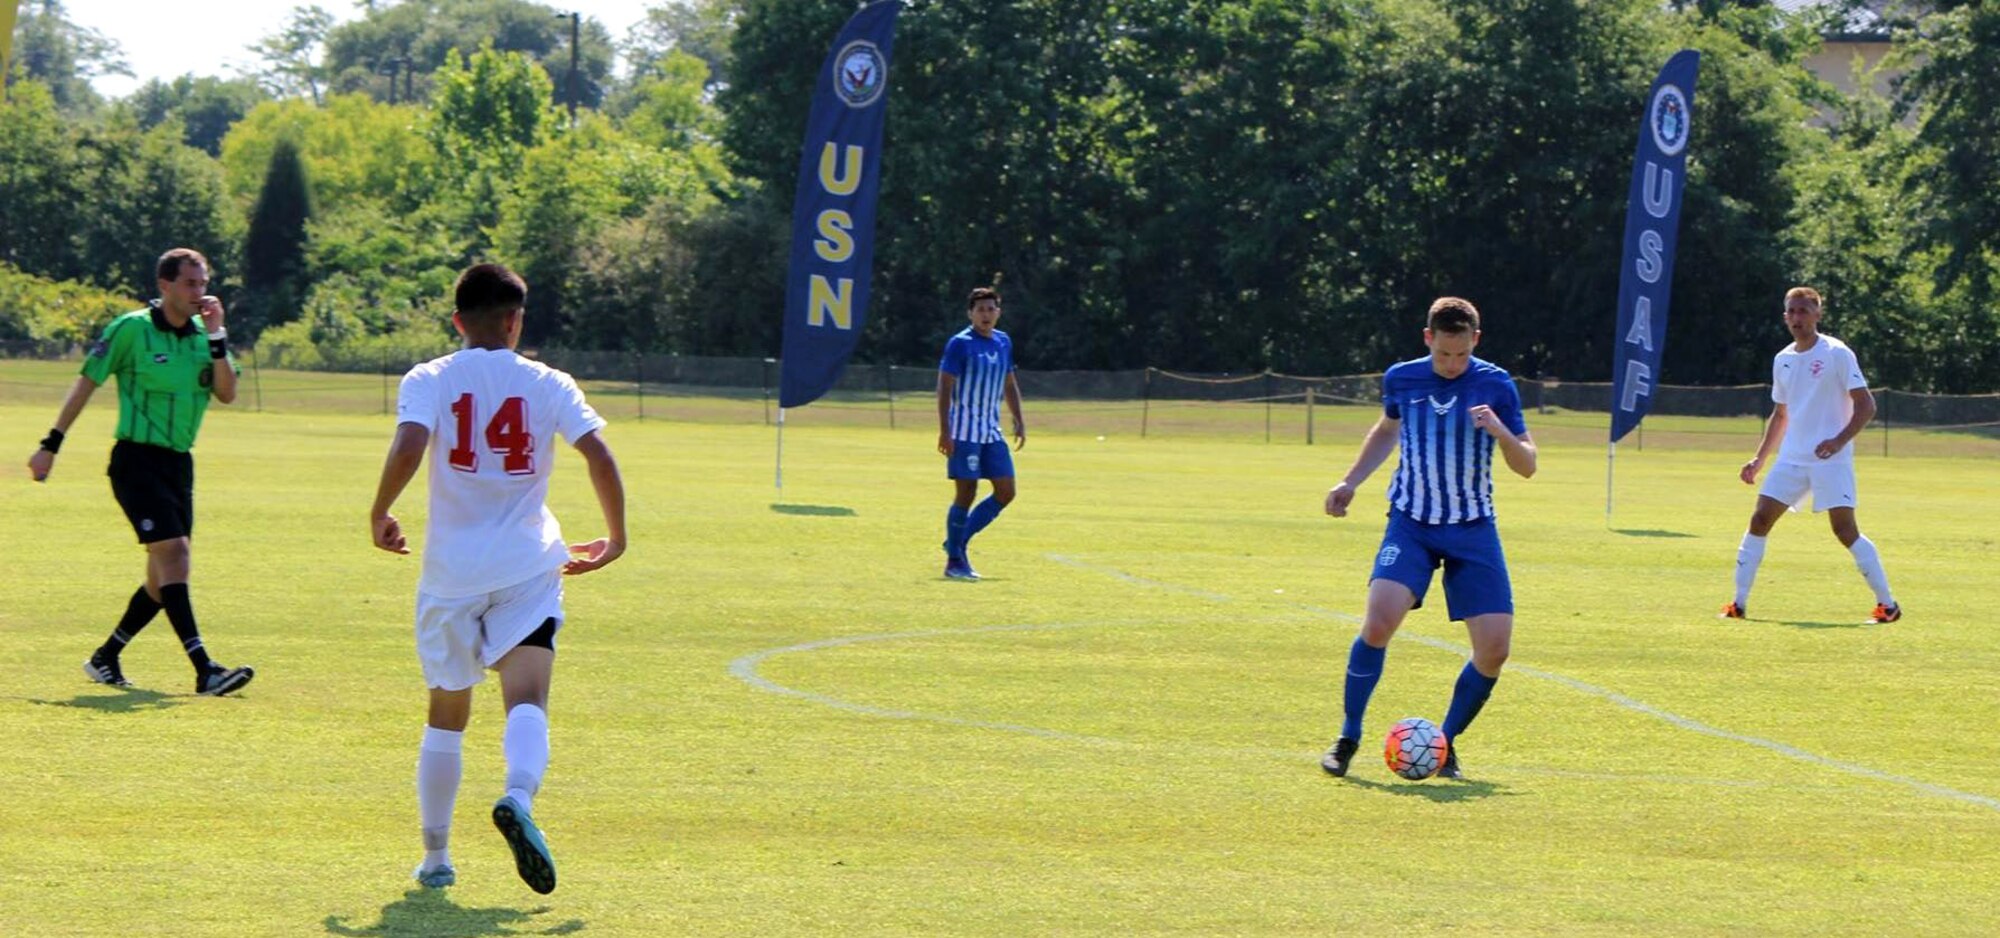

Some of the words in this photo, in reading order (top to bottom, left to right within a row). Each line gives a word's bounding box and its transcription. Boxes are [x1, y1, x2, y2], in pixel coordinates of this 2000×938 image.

[807, 141, 863, 330] USN
[1620, 161, 1673, 412] USAF
[449, 393, 536, 476] 14
